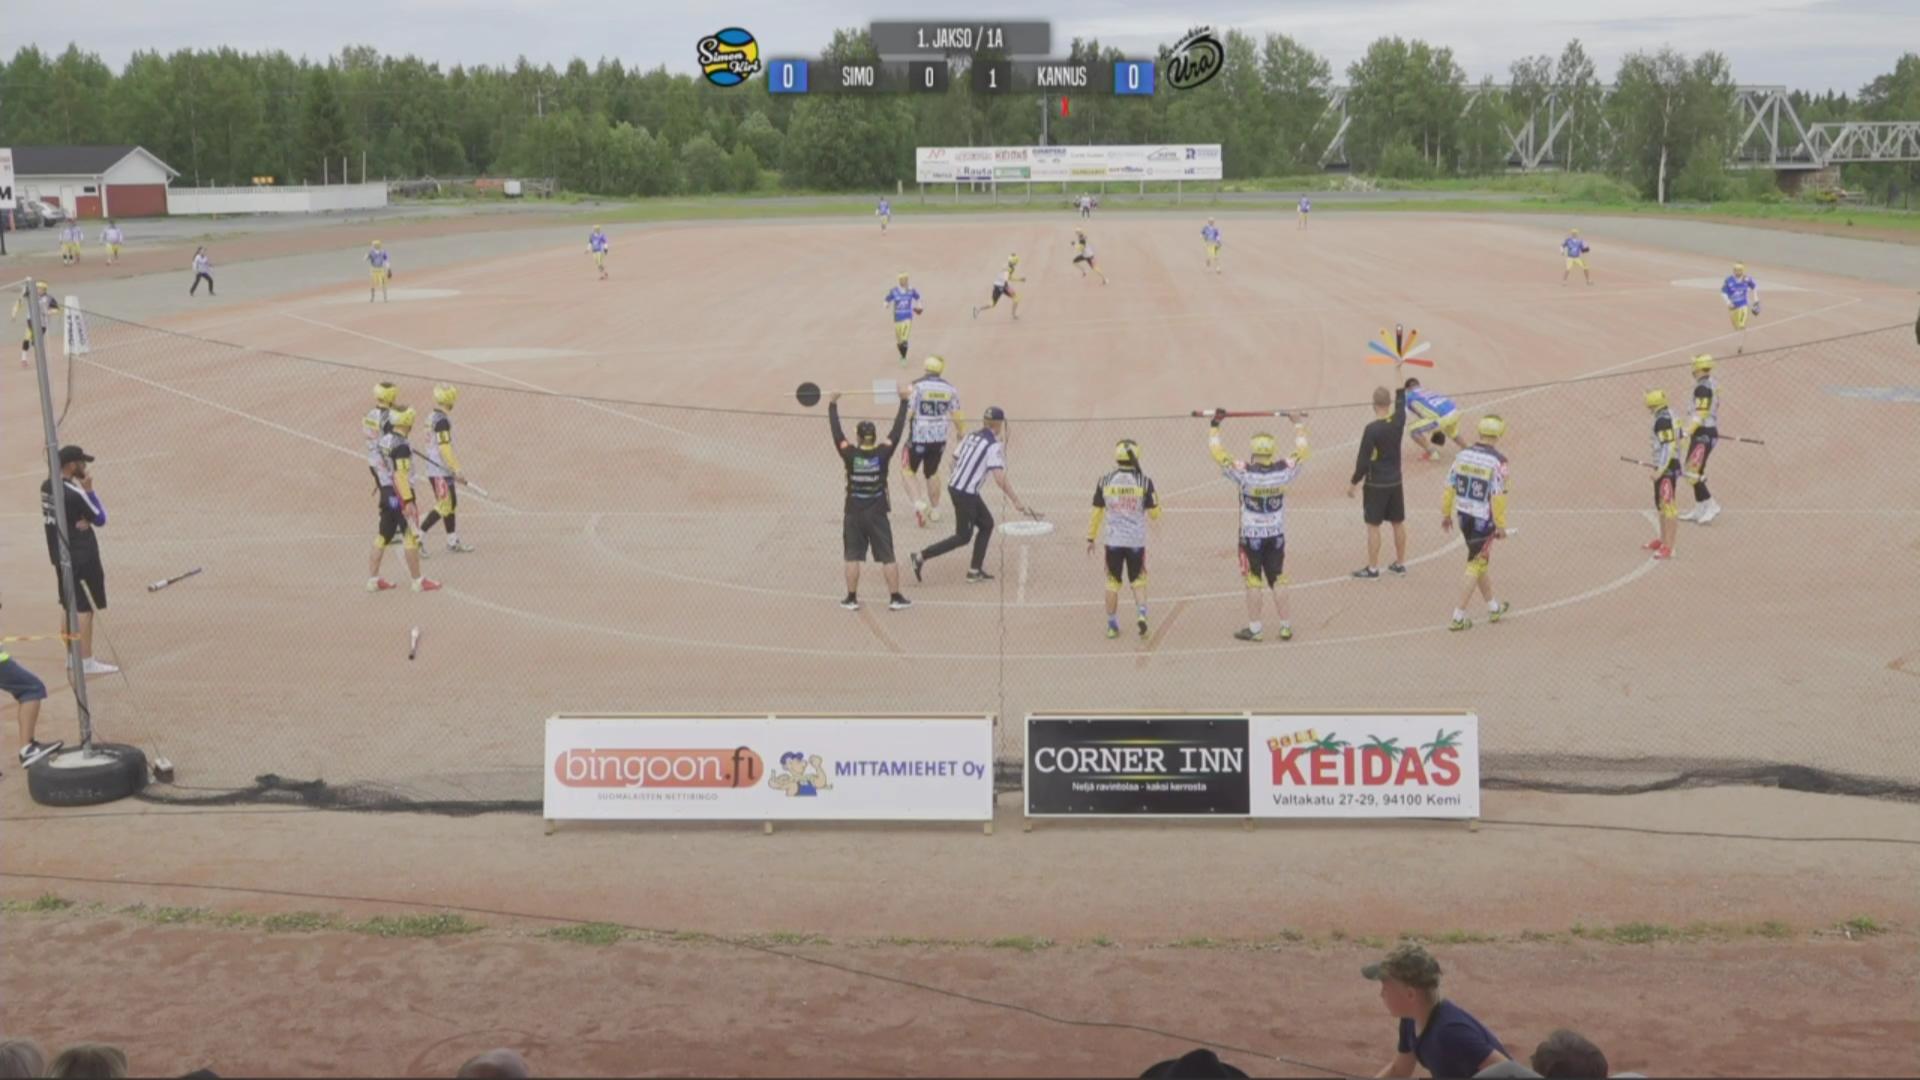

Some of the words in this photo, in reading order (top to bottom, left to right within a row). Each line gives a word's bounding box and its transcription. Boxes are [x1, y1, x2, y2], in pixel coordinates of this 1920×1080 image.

[565, 746, 756, 788] bingoon.fi
[835, 761, 958, 776] MITTAMIEHET
[962, 761, 985, 780] Oy
[1034, 747, 1167, 773] CORNER
[1179, 748, 1244, 773] INN
[1272, 747, 1462, 787] KEIDAS
[1096, 782, 1139, 792] ravintolaa
[1146, 782, 1169, 792] kaksi
[1171, 782, 1207, 792] kerrosta
[1273, 794, 1334, 807] Valtakatu
[1383, 794, 1423, 807] 94100
[1426, 793, 1461, 807] Kemi
